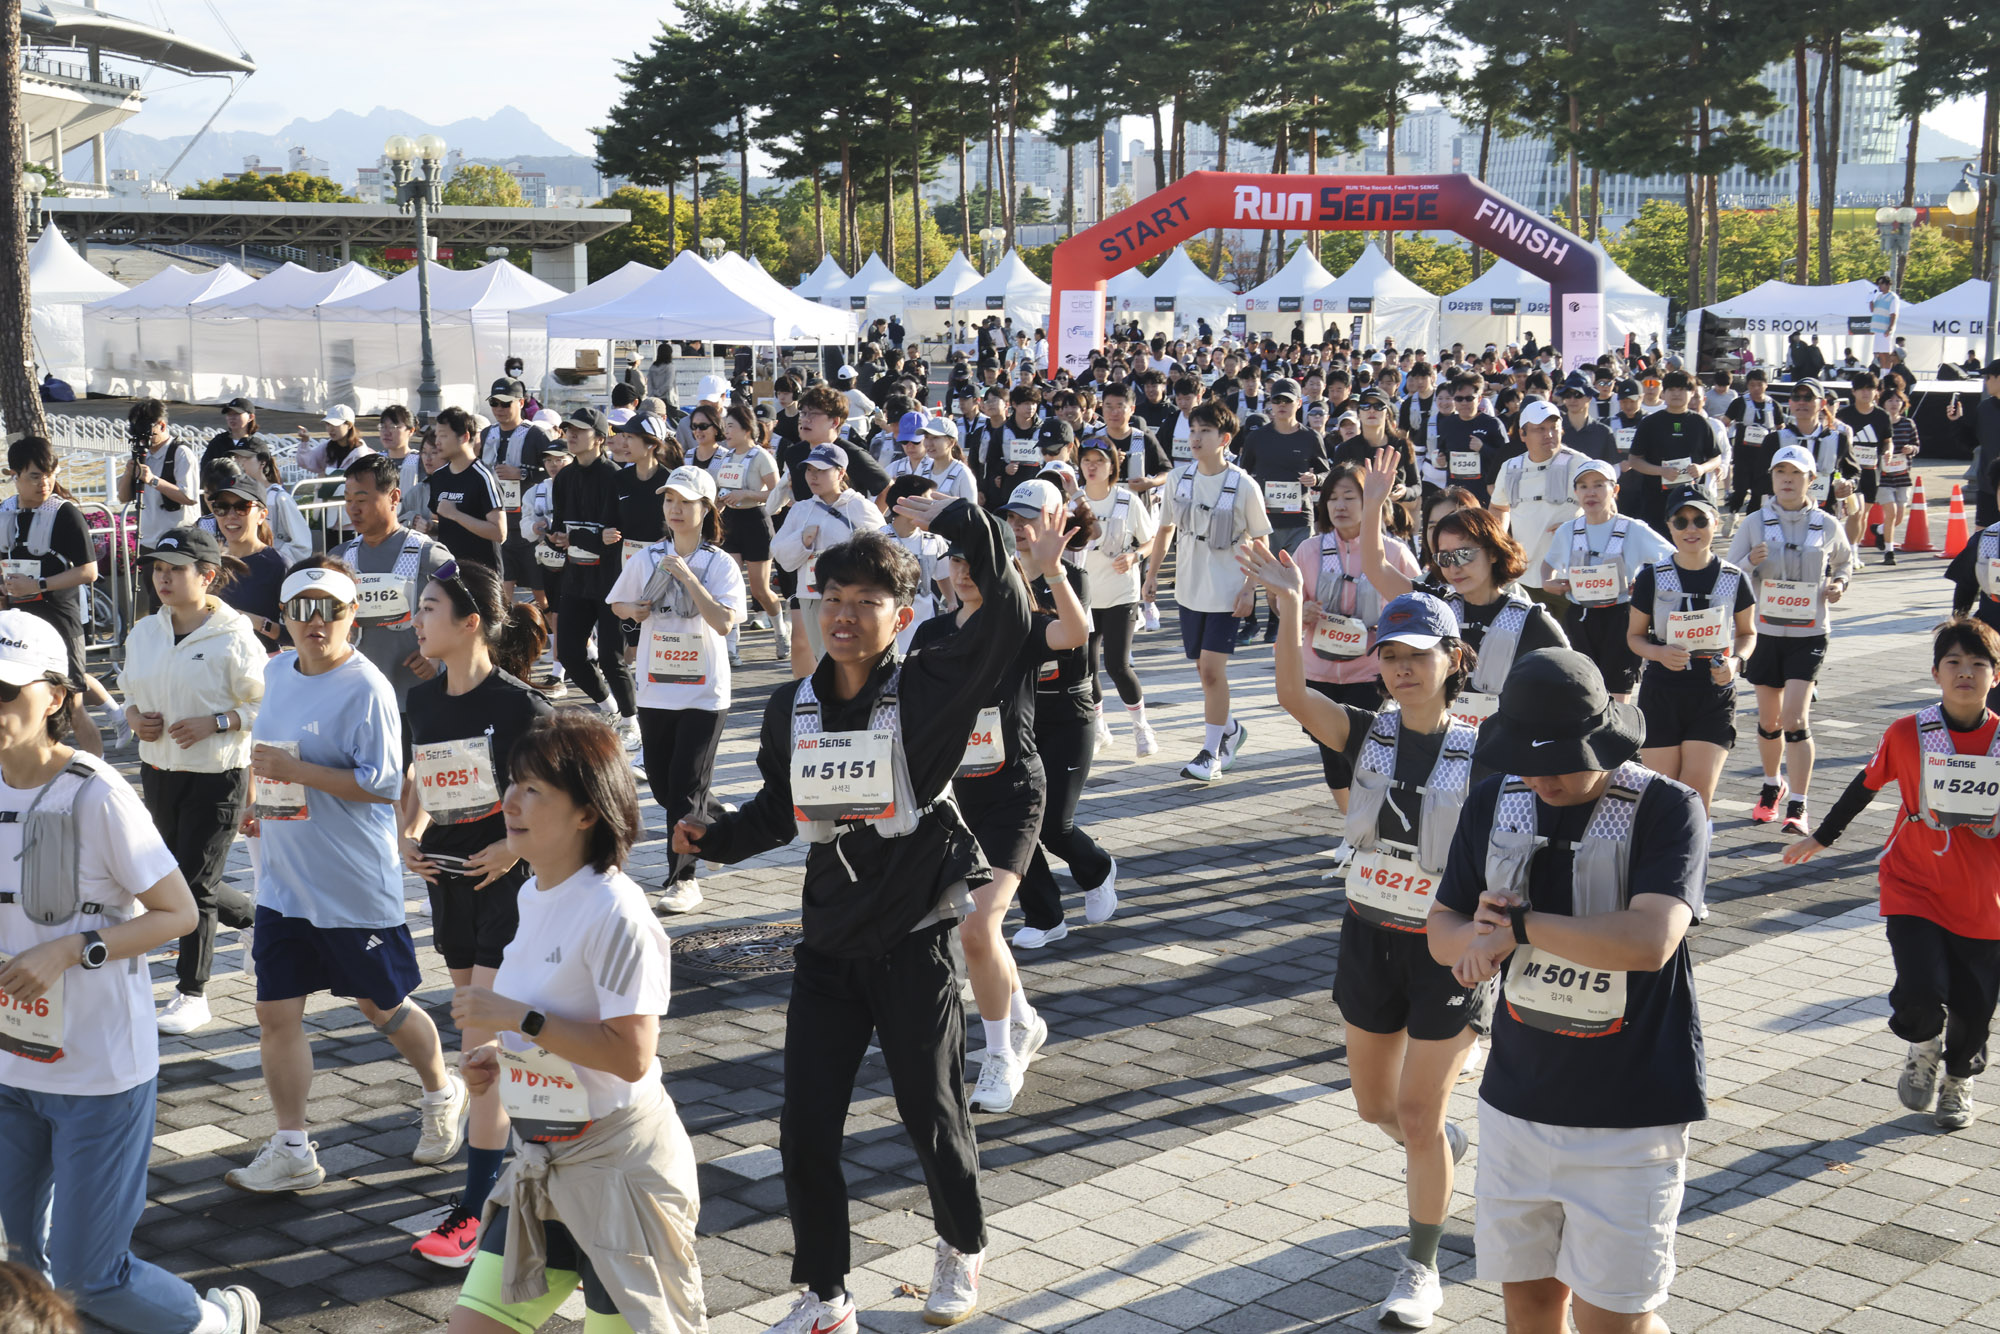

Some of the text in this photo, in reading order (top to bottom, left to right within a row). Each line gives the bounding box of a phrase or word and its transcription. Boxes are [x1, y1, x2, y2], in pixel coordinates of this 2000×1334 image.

[1100, 196, 1191, 263] START
[1474, 197, 1569, 266] FINISH
[1772, 320, 1818, 332] ROOM
[1932, 320, 1961, 334] MC
[1276, 492, 1298, 500] 5146
[543, 551, 566, 560] 5185
[1585, 578, 1613, 589] 6094
[365, 590, 398, 602] 5162
[1777, 596, 1810, 607] 6089
[1320, 628, 1360, 644] W 6092
[1674, 624, 1722, 639] W 6087
[656, 650, 699, 661] W 6222
[797, 739, 818, 750] Run
[967, 731, 992, 746] 94
[1928, 756, 1946, 766] Run
[422, 767, 479, 788] W 6251
[801, 760, 876, 780] M 5151
[1933, 779, 1999, 796] M 5240
[1360, 866, 1432, 896] W 6212
[1523, 962, 1611, 993] M 5015
[510, 1067, 522, 1084] W
